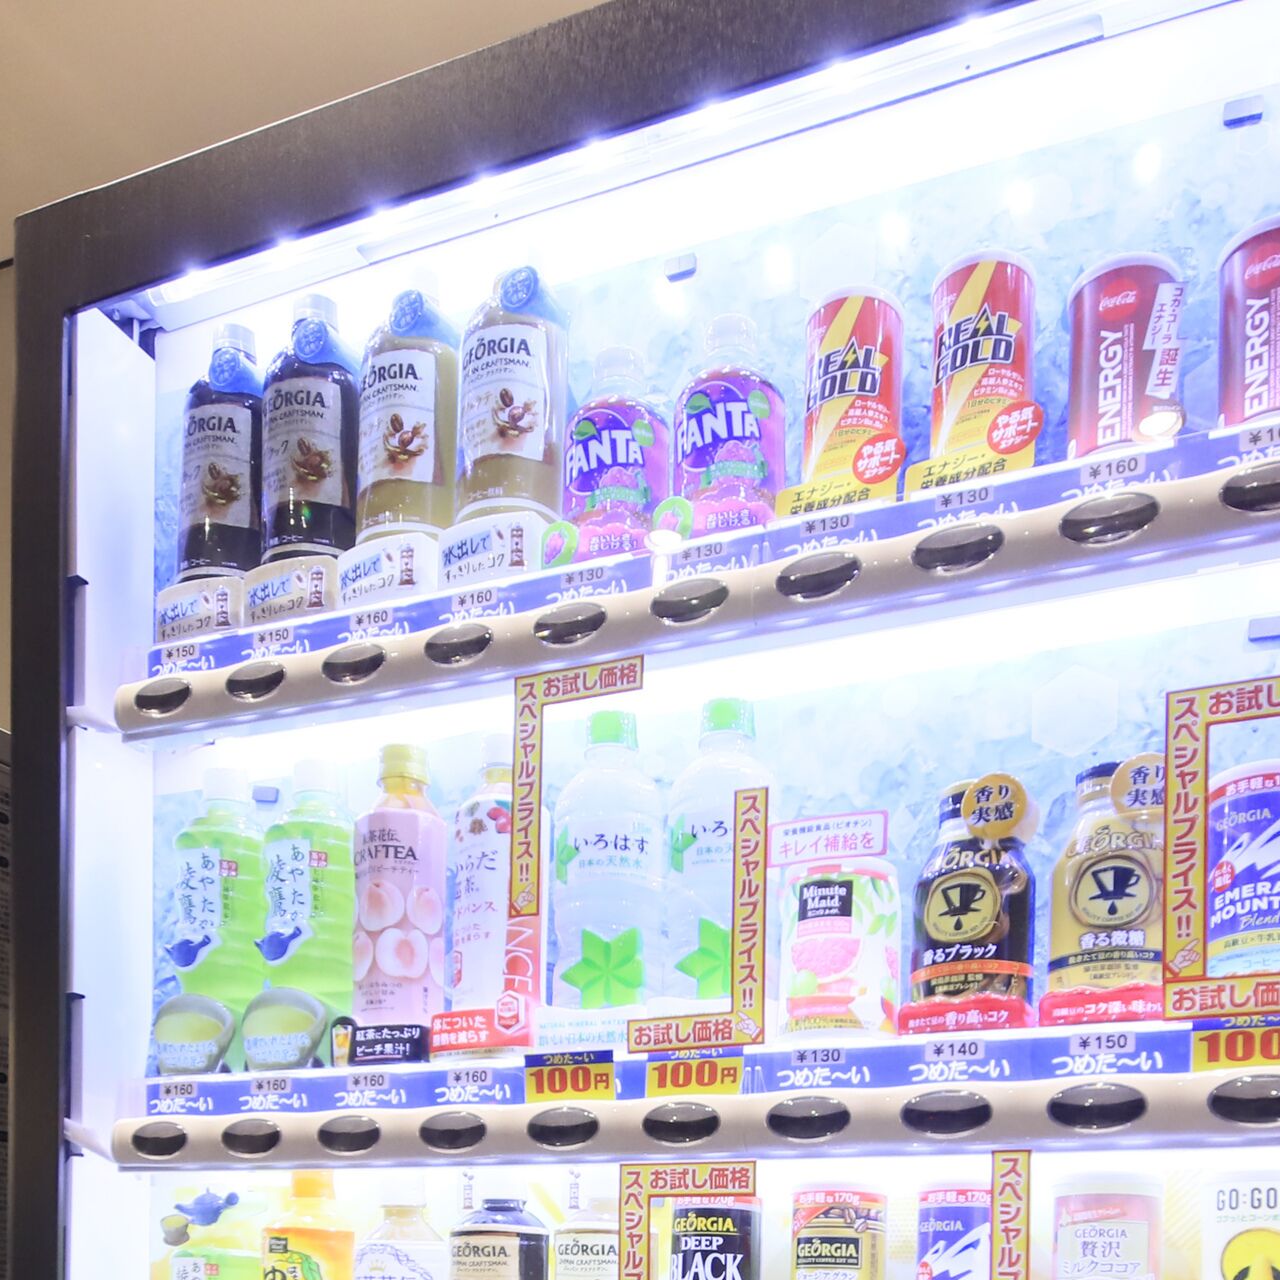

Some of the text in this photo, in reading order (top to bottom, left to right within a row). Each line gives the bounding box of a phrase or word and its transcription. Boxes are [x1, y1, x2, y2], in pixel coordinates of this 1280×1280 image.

[934, 336, 1016, 389] GOLD
[1244, 297, 1268, 418] ENERGY
[1154, 349, 1178, 387] 誕生
[1097, 330, 1122, 446] ENERGY
[995, 407, 1035, 427] やる気
[676, 401, 761, 464] FANTA
[566, 428, 645, 486] FANTA
[861, 438, 896, 456] やる気
[1089, 457, 1139, 480] ¥160
[941, 487, 989, 509] ¥130
[804, 515, 850, 534] ¥130
[443, 535, 491, 566] 水出しで
[682, 543, 723, 561] ¥130
[339, 555, 379, 586] 水出しで
[565, 567, 604, 584] ¥130
[248, 580, 288, 606] 水出しで
[457, 590, 493, 606] ¥160
[160, 601, 196, 622] 水出しで
[355, 612, 388, 625] ¥160
[258, 630, 289, 643] ¥150
[166, 645, 195, 657] ¥150
[543, 662, 638, 698] お試し価格
[975, 784, 1010, 804] 香り
[971, 805, 1014, 825] 実感
[779, 833, 873, 858] キレイ補給を
[199, 853, 214, 929] あやたか
[289, 844, 305, 921] あやたか
[803, 885, 846, 900] Minute
[807, 897, 841, 910] Maid
[1080, 930, 1145, 950] 香る微糖
[922, 944, 996, 966] 香るブラック
[356, 1026, 420, 1041] 紅茶にたっぷり
[633, 1018, 734, 1046] お試し価格
[932, 1041, 979, 1057] ¥140
[1078, 1034, 1128, 1051] ¥150
[797, 1048, 840, 1064] ¥130
[352, 1075, 385, 1088] ¥160
[452, 1070, 487, 1084] ¥160
[530, 1067, 609, 1093] 100円
[652, 1062, 737, 1088] 100円
[164, 1083, 193, 1097] ¥160
[255, 1079, 287, 1092] ¥160
[650, 1168, 751, 1190] お試し価格
[681, 1236, 723, 1251] DEEP
[1080, 1240, 1121, 1259] 贅沢
[1063, 1261, 1141, 1276] ミルクココア
